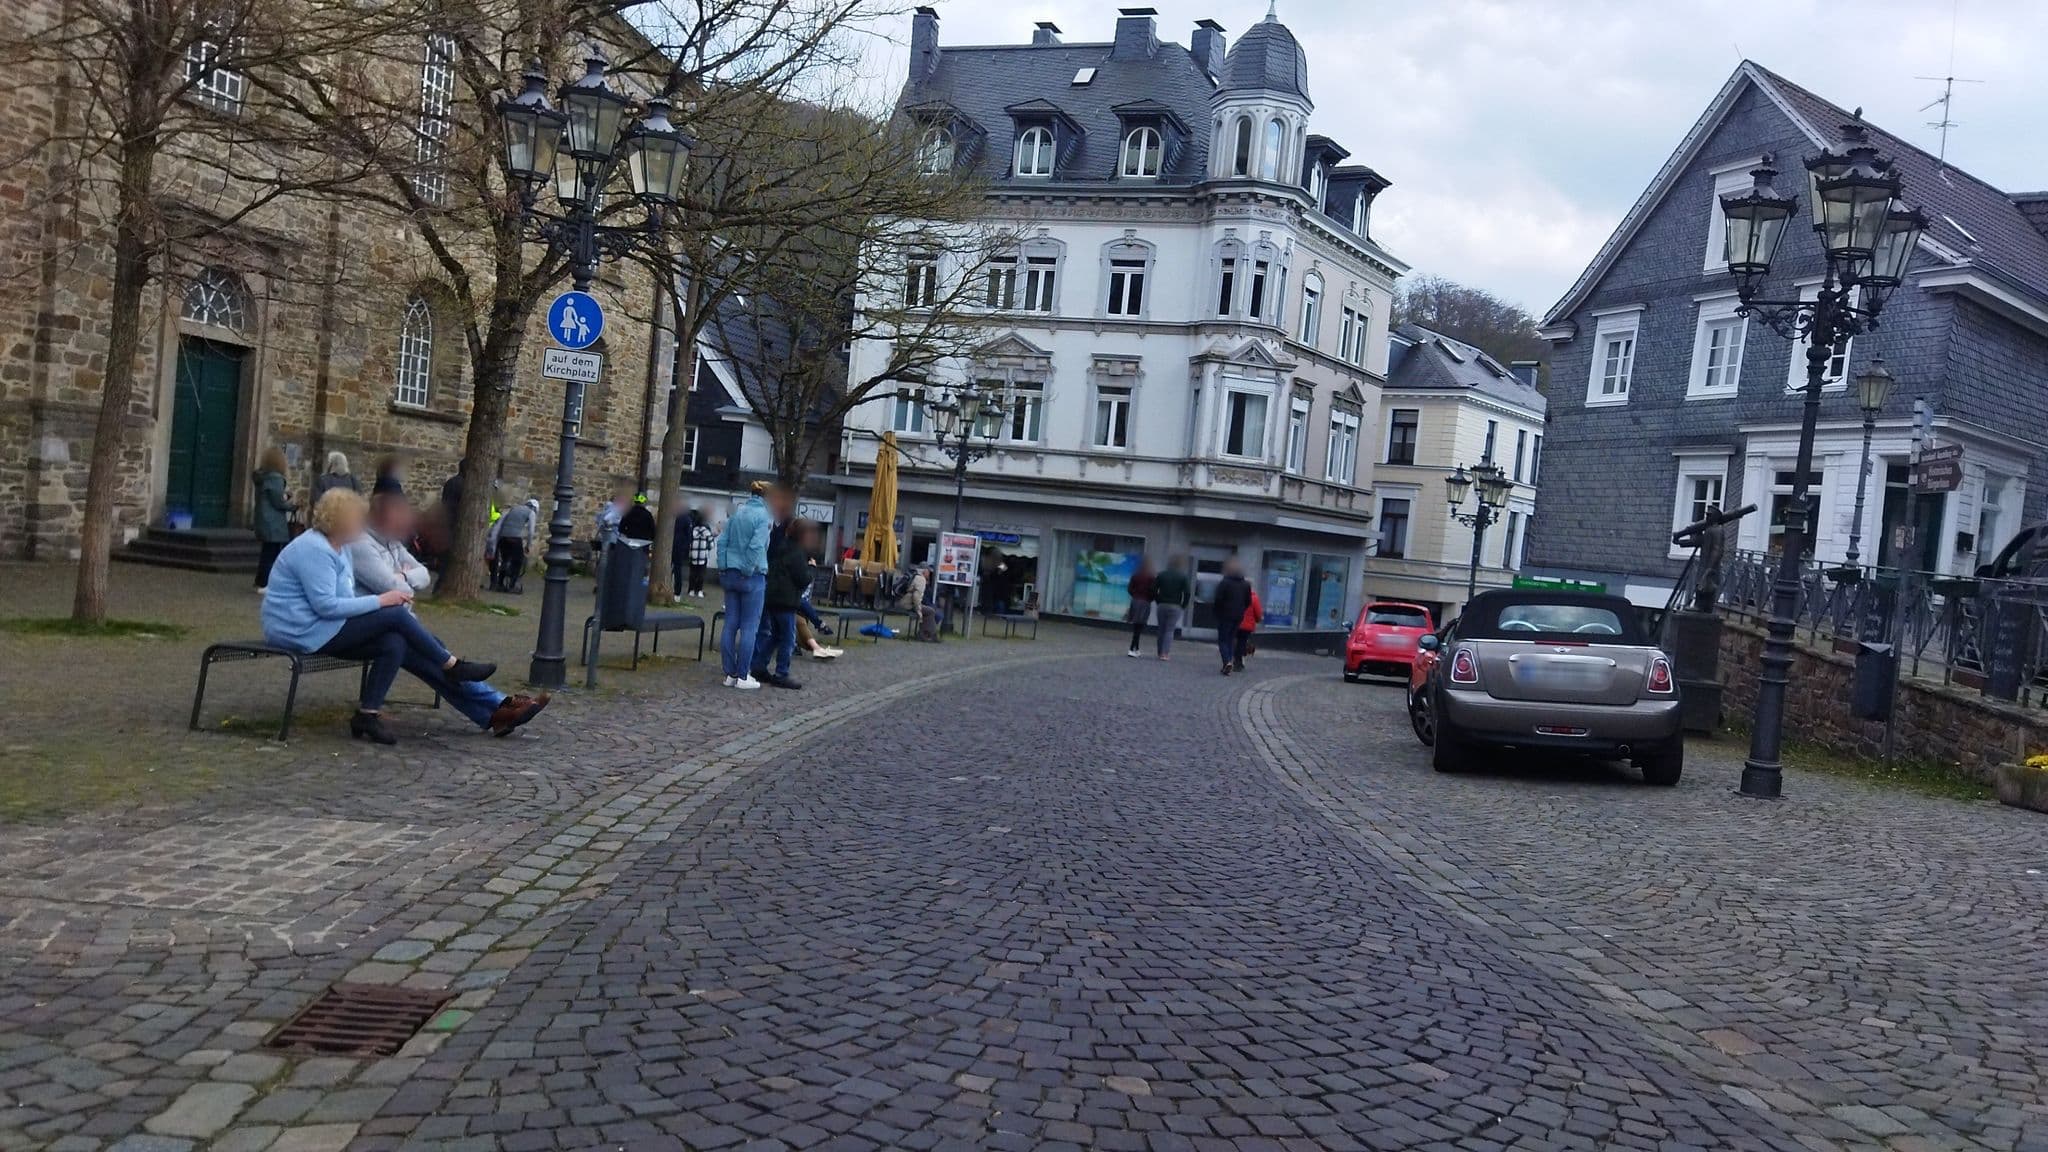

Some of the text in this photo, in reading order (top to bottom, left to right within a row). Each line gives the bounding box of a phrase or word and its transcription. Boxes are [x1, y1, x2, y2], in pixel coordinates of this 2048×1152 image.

[551, 355, 594, 367] auf dem
[546, 364, 597, 379] Kirchplatz
